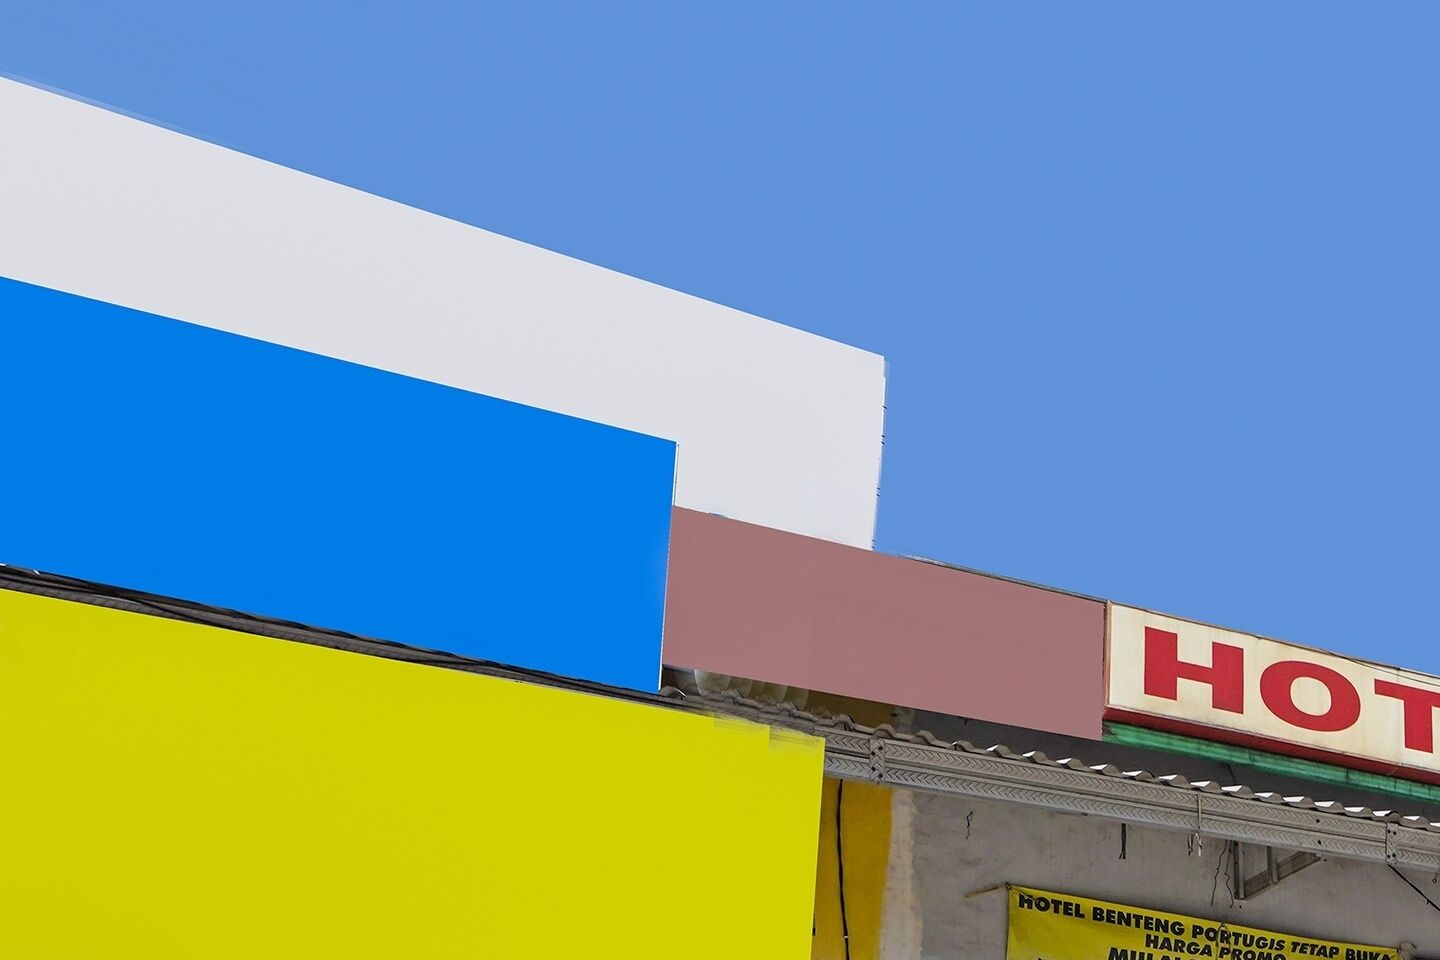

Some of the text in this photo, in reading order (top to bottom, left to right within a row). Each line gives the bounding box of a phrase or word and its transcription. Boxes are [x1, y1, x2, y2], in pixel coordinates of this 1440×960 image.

[1018, 893, 1085, 919] HOTEL
[1092, 906, 1185, 936] BENTENG
[1192, 924, 1286, 951] PORTUGIS
[1290, 941, 1339, 959] TETAP
[1145, 933, 1212, 957] HARGA
